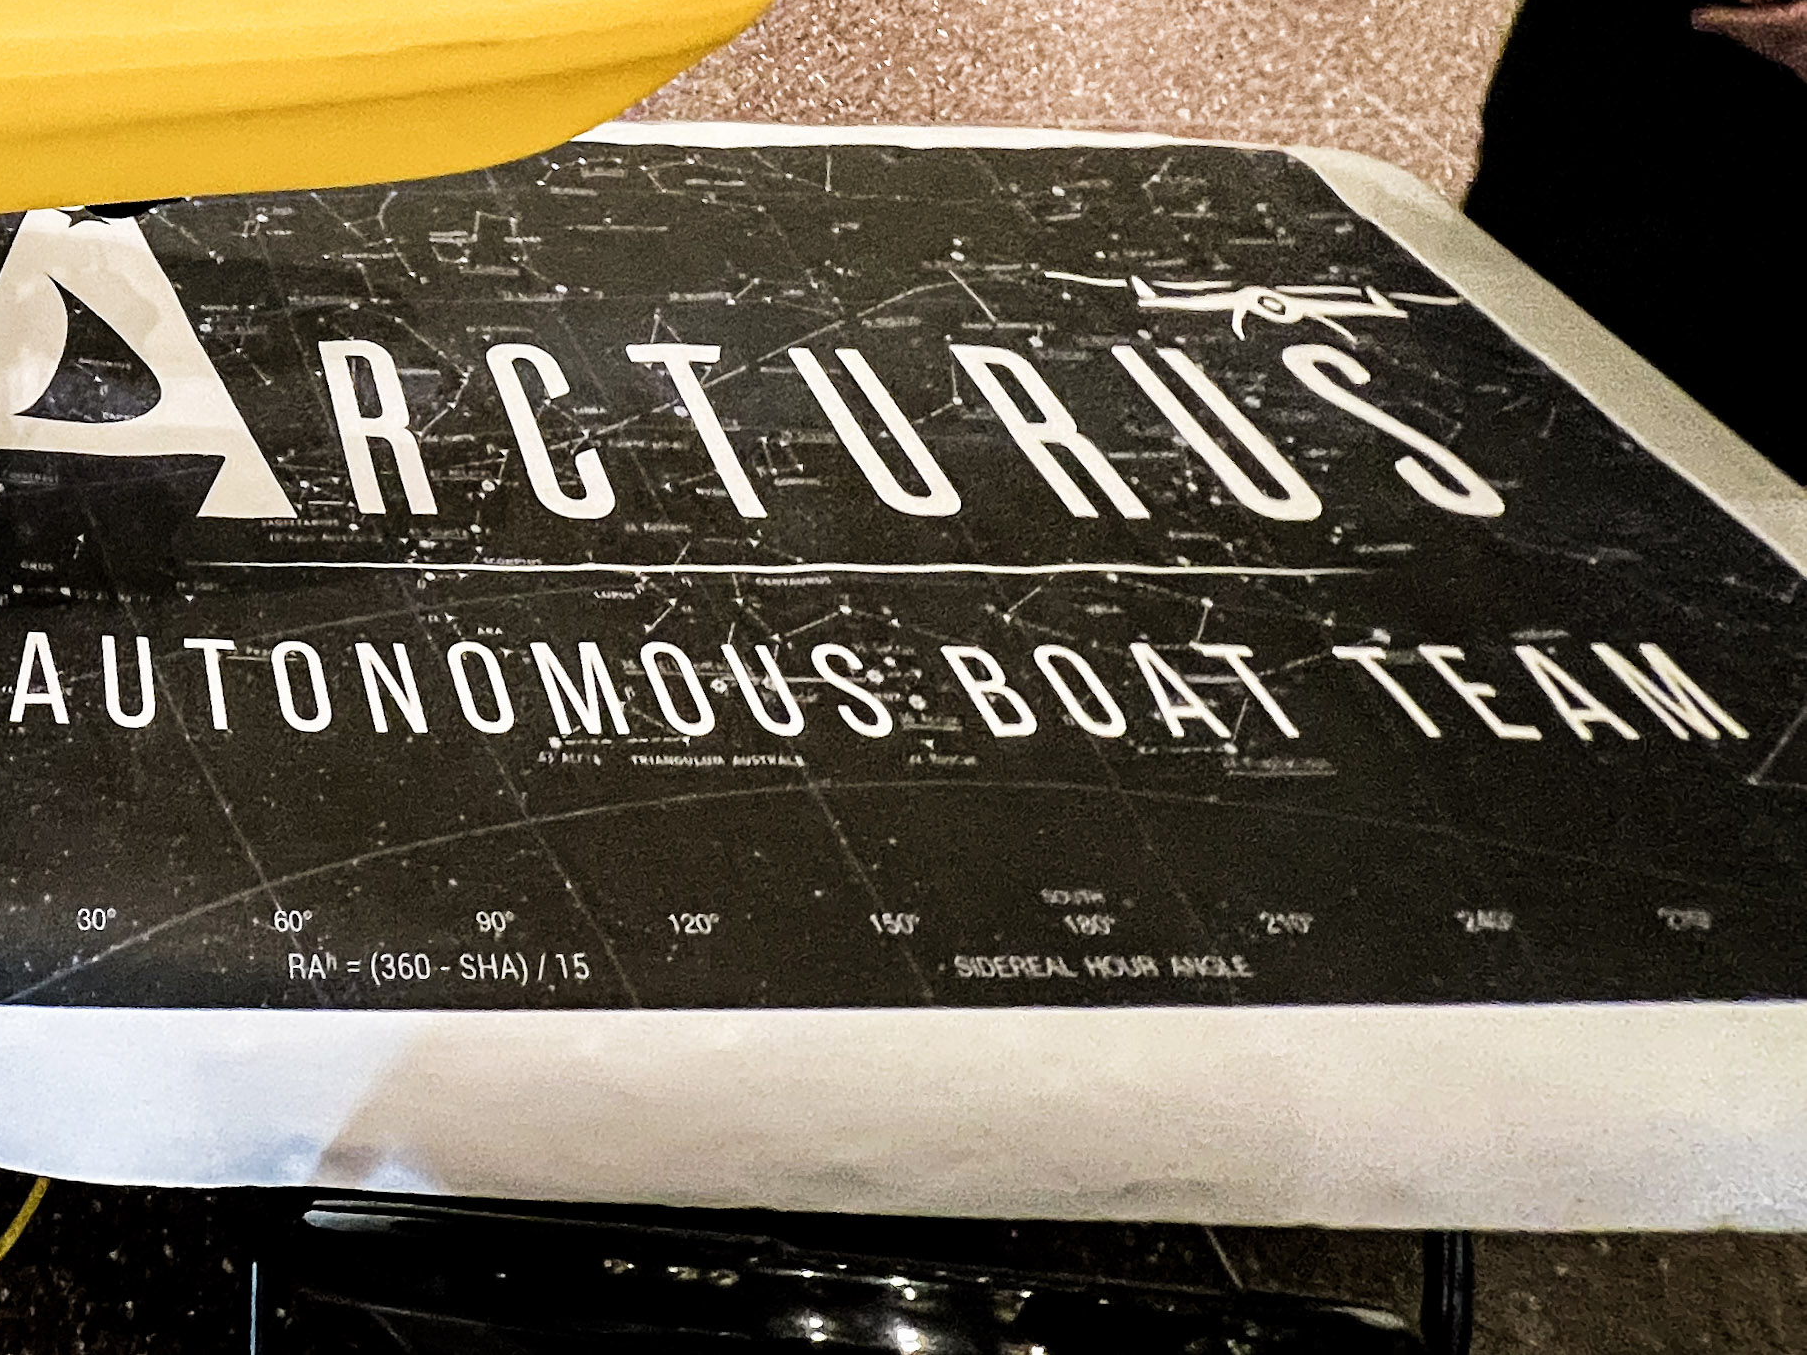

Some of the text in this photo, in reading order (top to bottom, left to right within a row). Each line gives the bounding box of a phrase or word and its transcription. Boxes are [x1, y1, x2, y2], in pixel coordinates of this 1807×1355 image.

[8, 631, 1749, 741] AUTONOMOUS BOAT TEAM
[76, 907, 117, 932] 30°
[273, 909, 314, 933] 60°
[475, 909, 516, 934] 90°
[667, 912, 720, 936] 120°
[868, 912, 920, 936] 150°
[345, 960, 362, 974] =
[370, 951, 432, 987] (360
[459, 951, 529, 987] SHA)
[537, 952, 547, 981] /
[555, 951, 591, 981] 15
[953, 954, 1255, 979] SIDEREAL HOUR ANGLE
